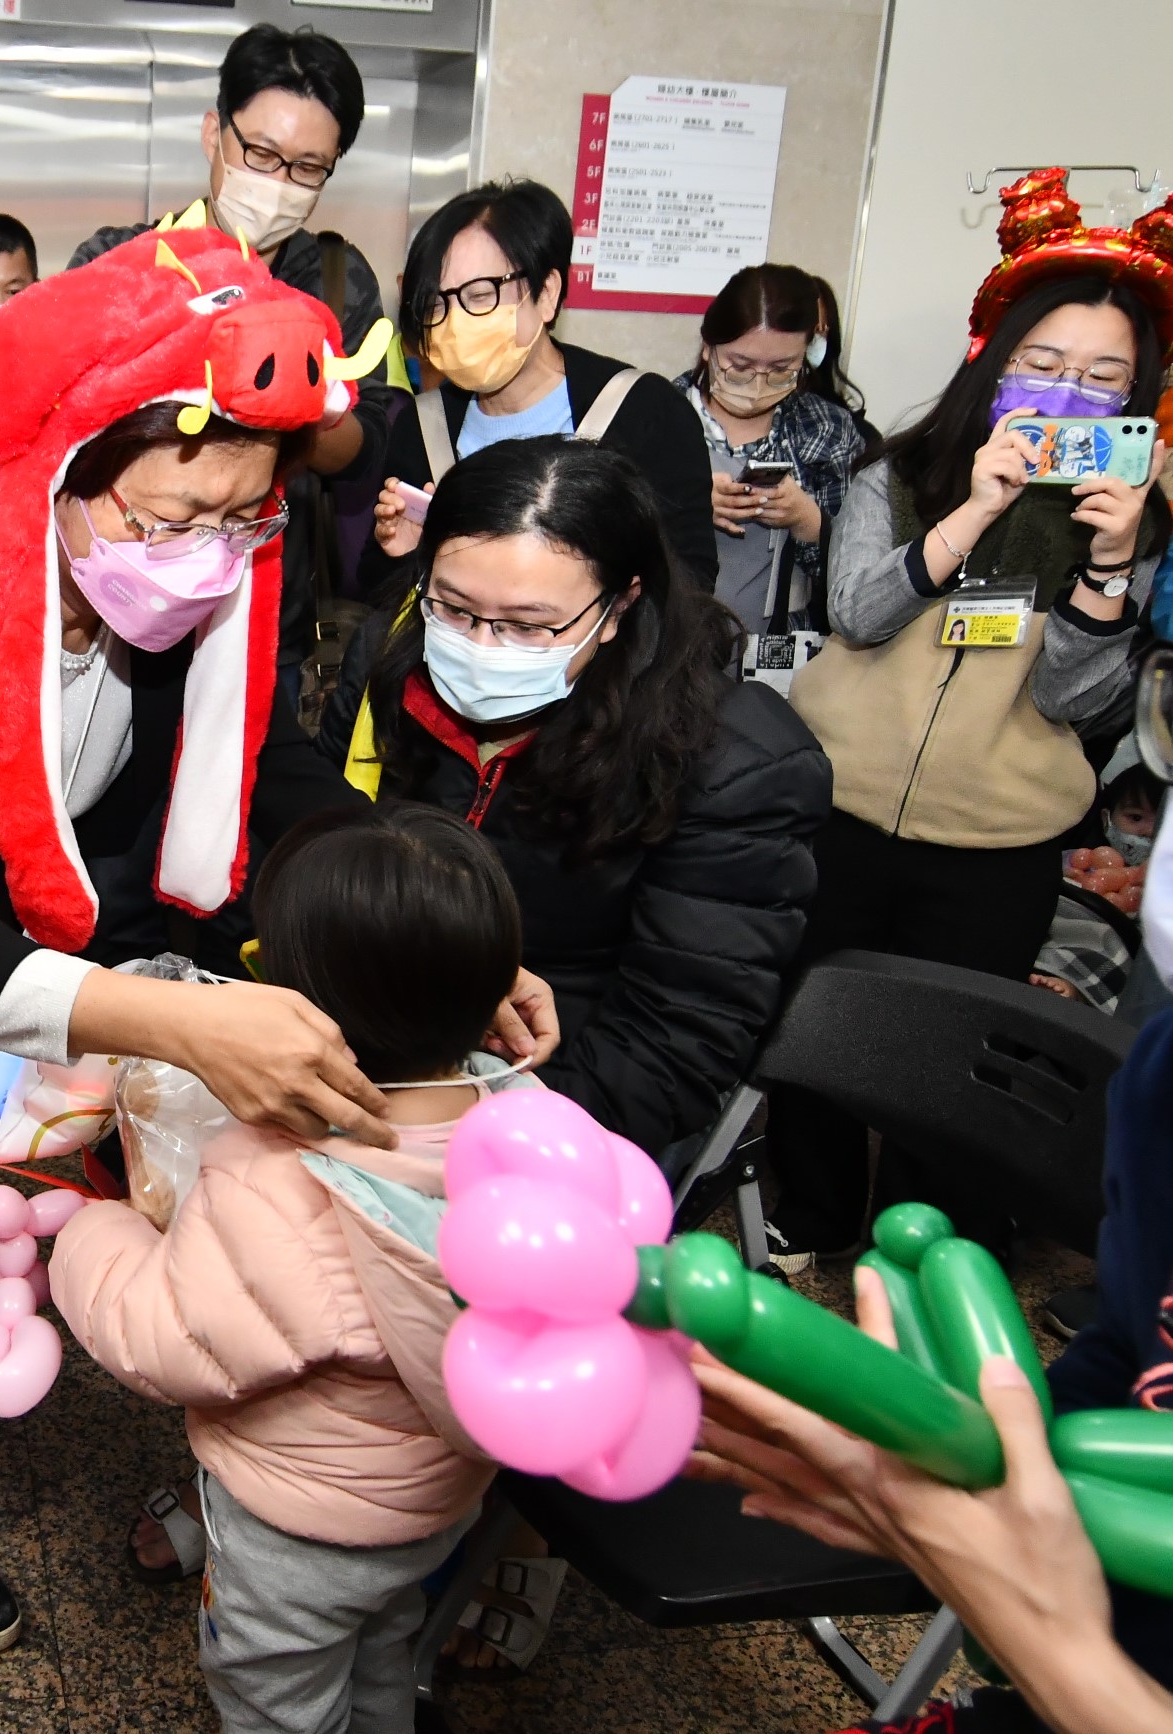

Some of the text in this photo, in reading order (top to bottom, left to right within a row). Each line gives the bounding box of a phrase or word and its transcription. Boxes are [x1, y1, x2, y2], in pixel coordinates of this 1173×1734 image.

[592, 112, 606, 124] 7F
[589, 138, 604, 151] 6F
[587, 165, 601, 178] 5F
[584, 192, 598, 205] 3F
[581, 219, 596, 232] 2F
[580, 245, 592, 255] 1F
[577, 271, 590, 283] B1
